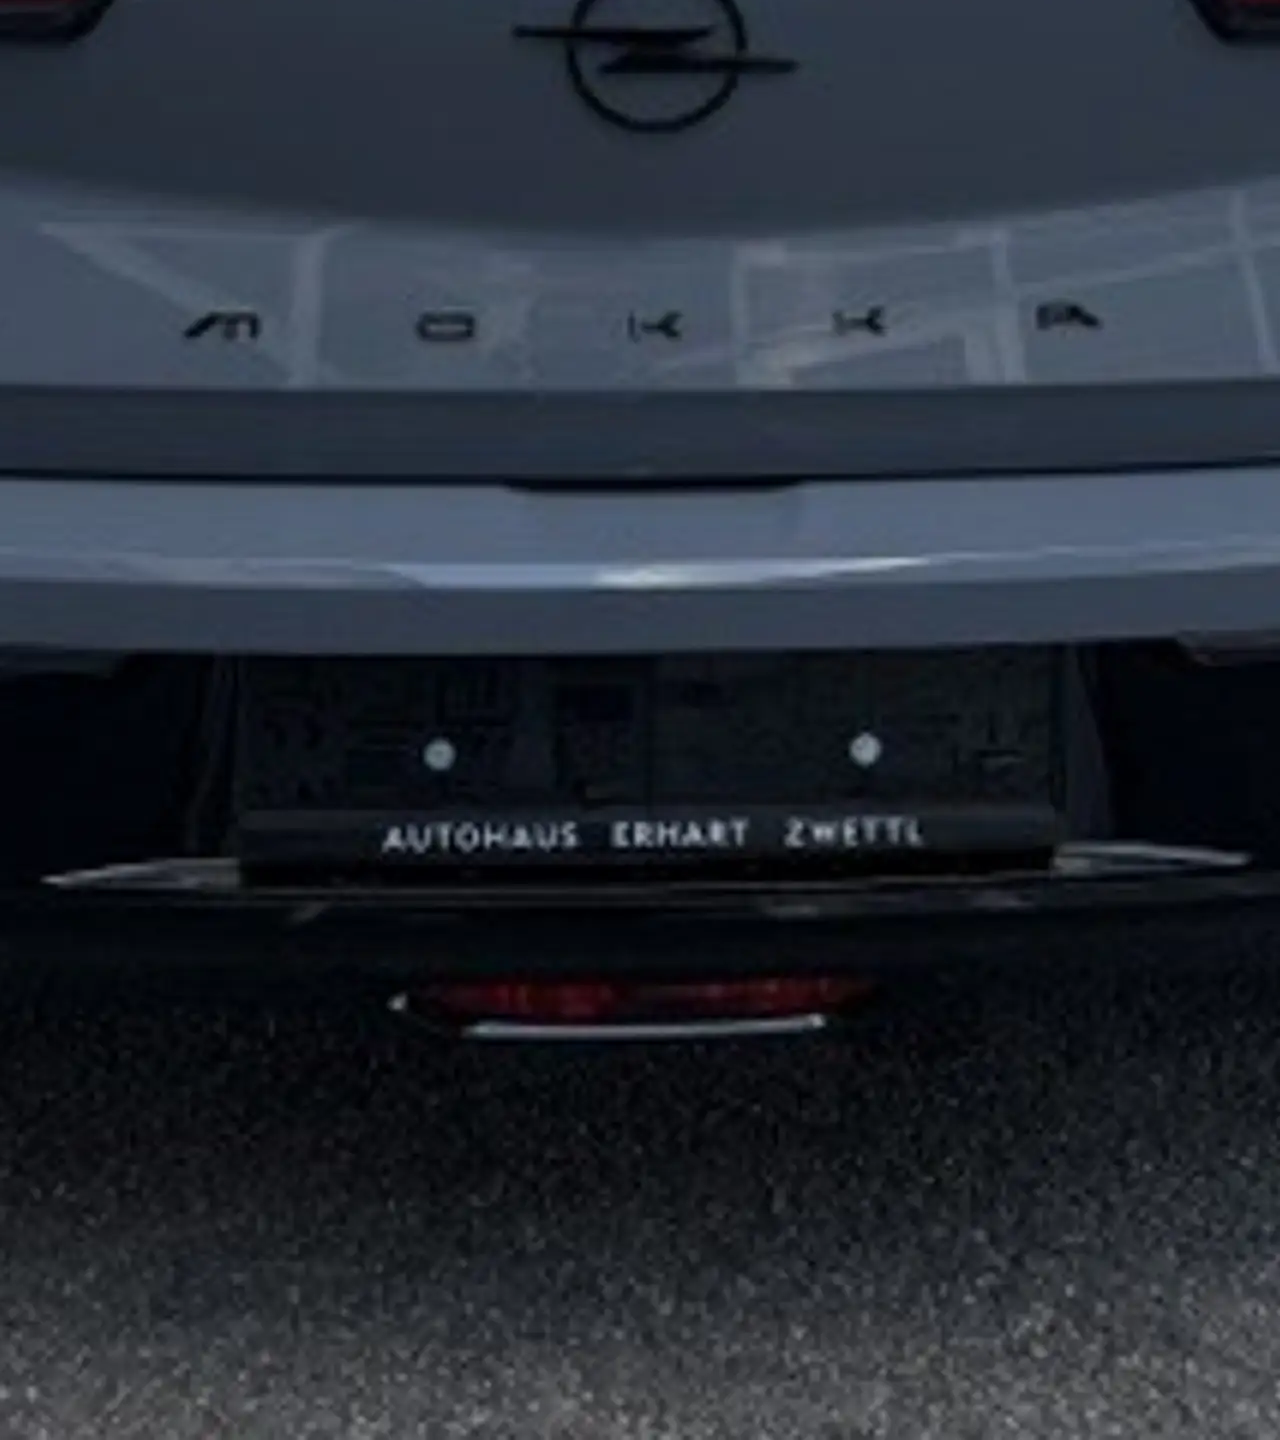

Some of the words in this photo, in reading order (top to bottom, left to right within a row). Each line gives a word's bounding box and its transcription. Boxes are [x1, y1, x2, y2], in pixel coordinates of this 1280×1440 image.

[184, 302, 1104, 342] MOKKA
[382, 821, 579, 855] AUTOHAUS
[613, 817, 750, 850] ERHART
[784, 815, 924, 849] ZWETTL
